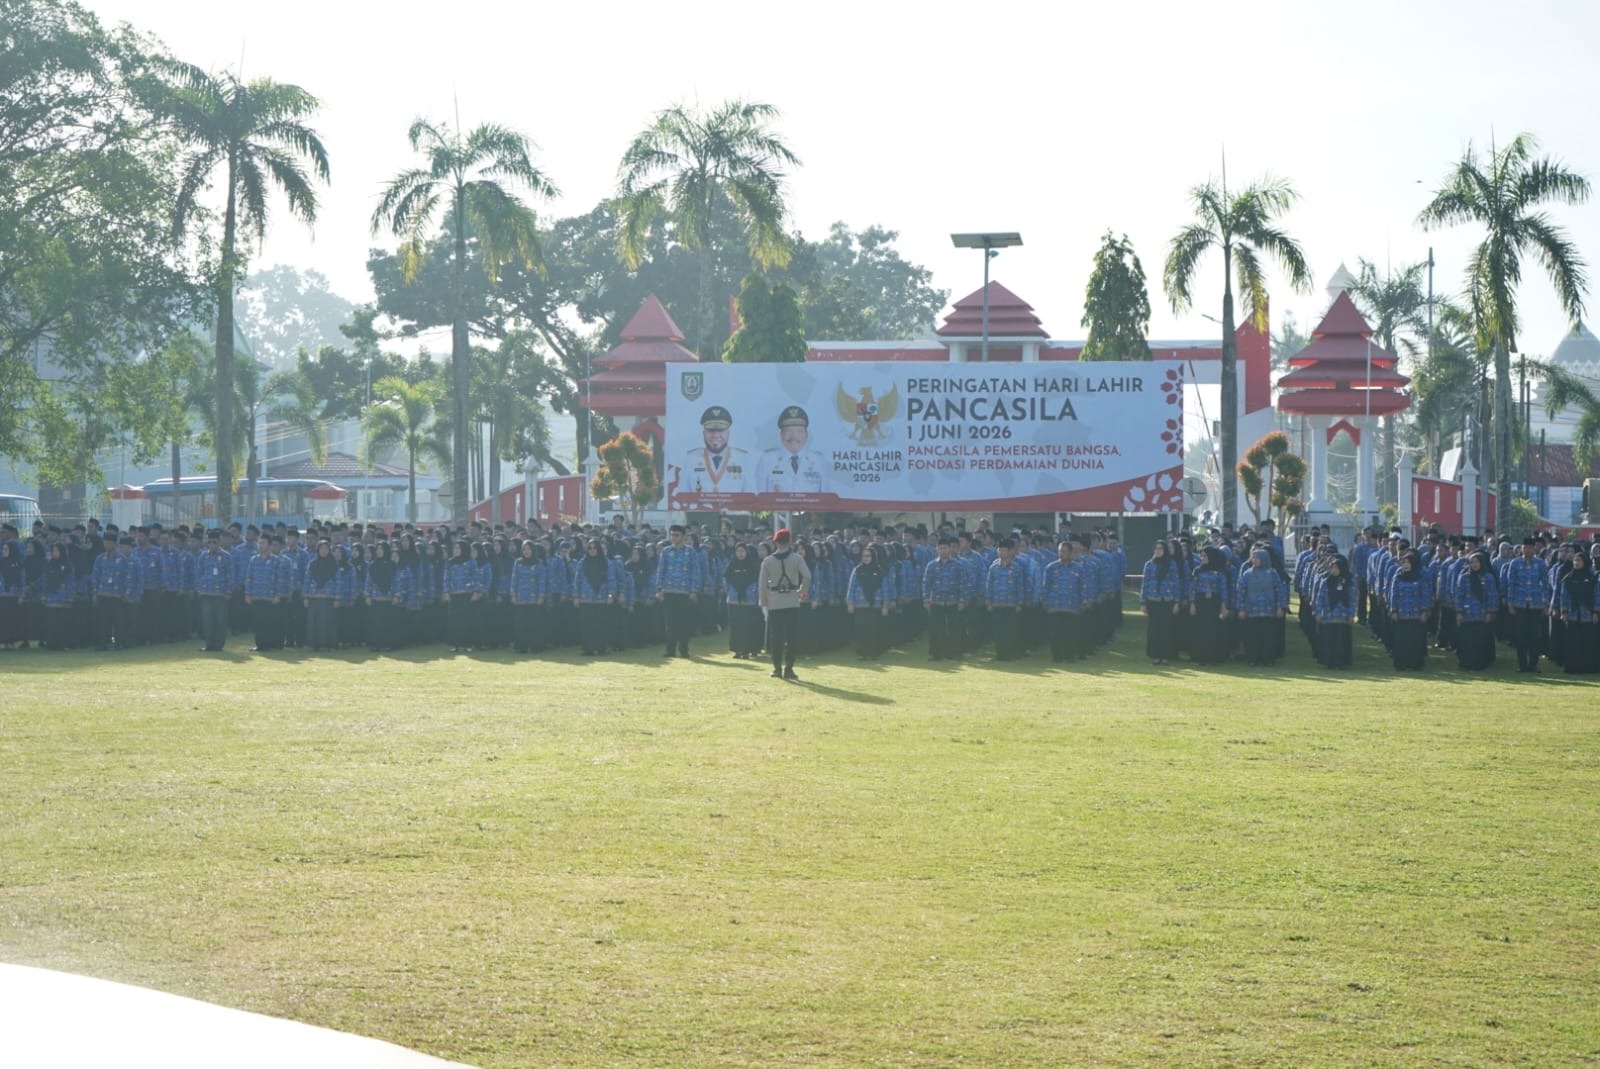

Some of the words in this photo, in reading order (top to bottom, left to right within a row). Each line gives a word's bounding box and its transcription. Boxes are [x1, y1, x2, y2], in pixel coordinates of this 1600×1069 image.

[907, 378, 1026, 393] PERINGATAN
[1034, 378, 1079, 393] HARI
[1086, 378, 1143, 392] LAHIR
[907, 398, 1078, 421] PANCASILA
[907, 425, 913, 439] 1
[918, 425, 961, 441] JUNI
[968, 425, 1012, 439] 2026
[908, 445, 980, 456] PANCASILA
[984, 445, 1062, 456] PEMERSATU
[832, 451, 862, 462] HARI
[866, 451, 902, 462] LAHIR
[833, 462, 901, 472] PANCASILA
[908, 459, 966, 470] FONDASI
[969, 459, 1057, 470] PERDAMAIAN
[1061, 459, 1105, 470] DUNIA
[853, 474, 881, 483] 2026
